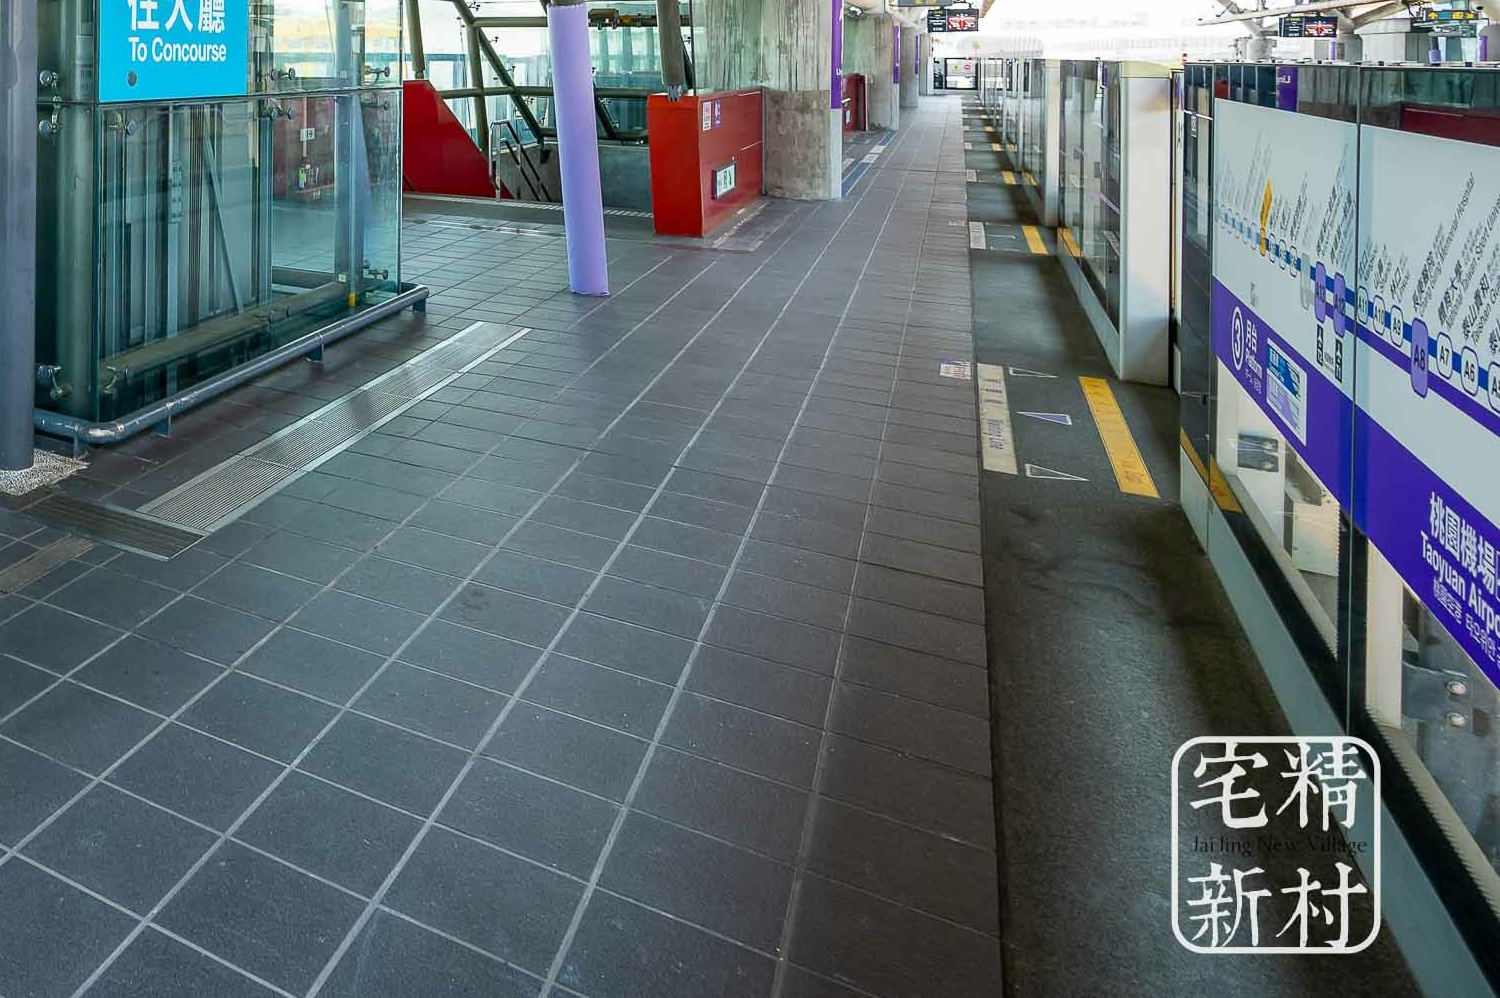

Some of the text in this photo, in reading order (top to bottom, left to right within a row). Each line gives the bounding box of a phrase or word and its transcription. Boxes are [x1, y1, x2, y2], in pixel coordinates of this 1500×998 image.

[128, 36, 227, 62] To Concourse
[1413, 344, 1426, 371] A8
[1439, 348, 1450, 366] A7
[1464, 360, 1475, 383] A6
[1429, 491, 1495, 594] 桃園機場
[1420, 530, 1466, 601] Taoyuan
